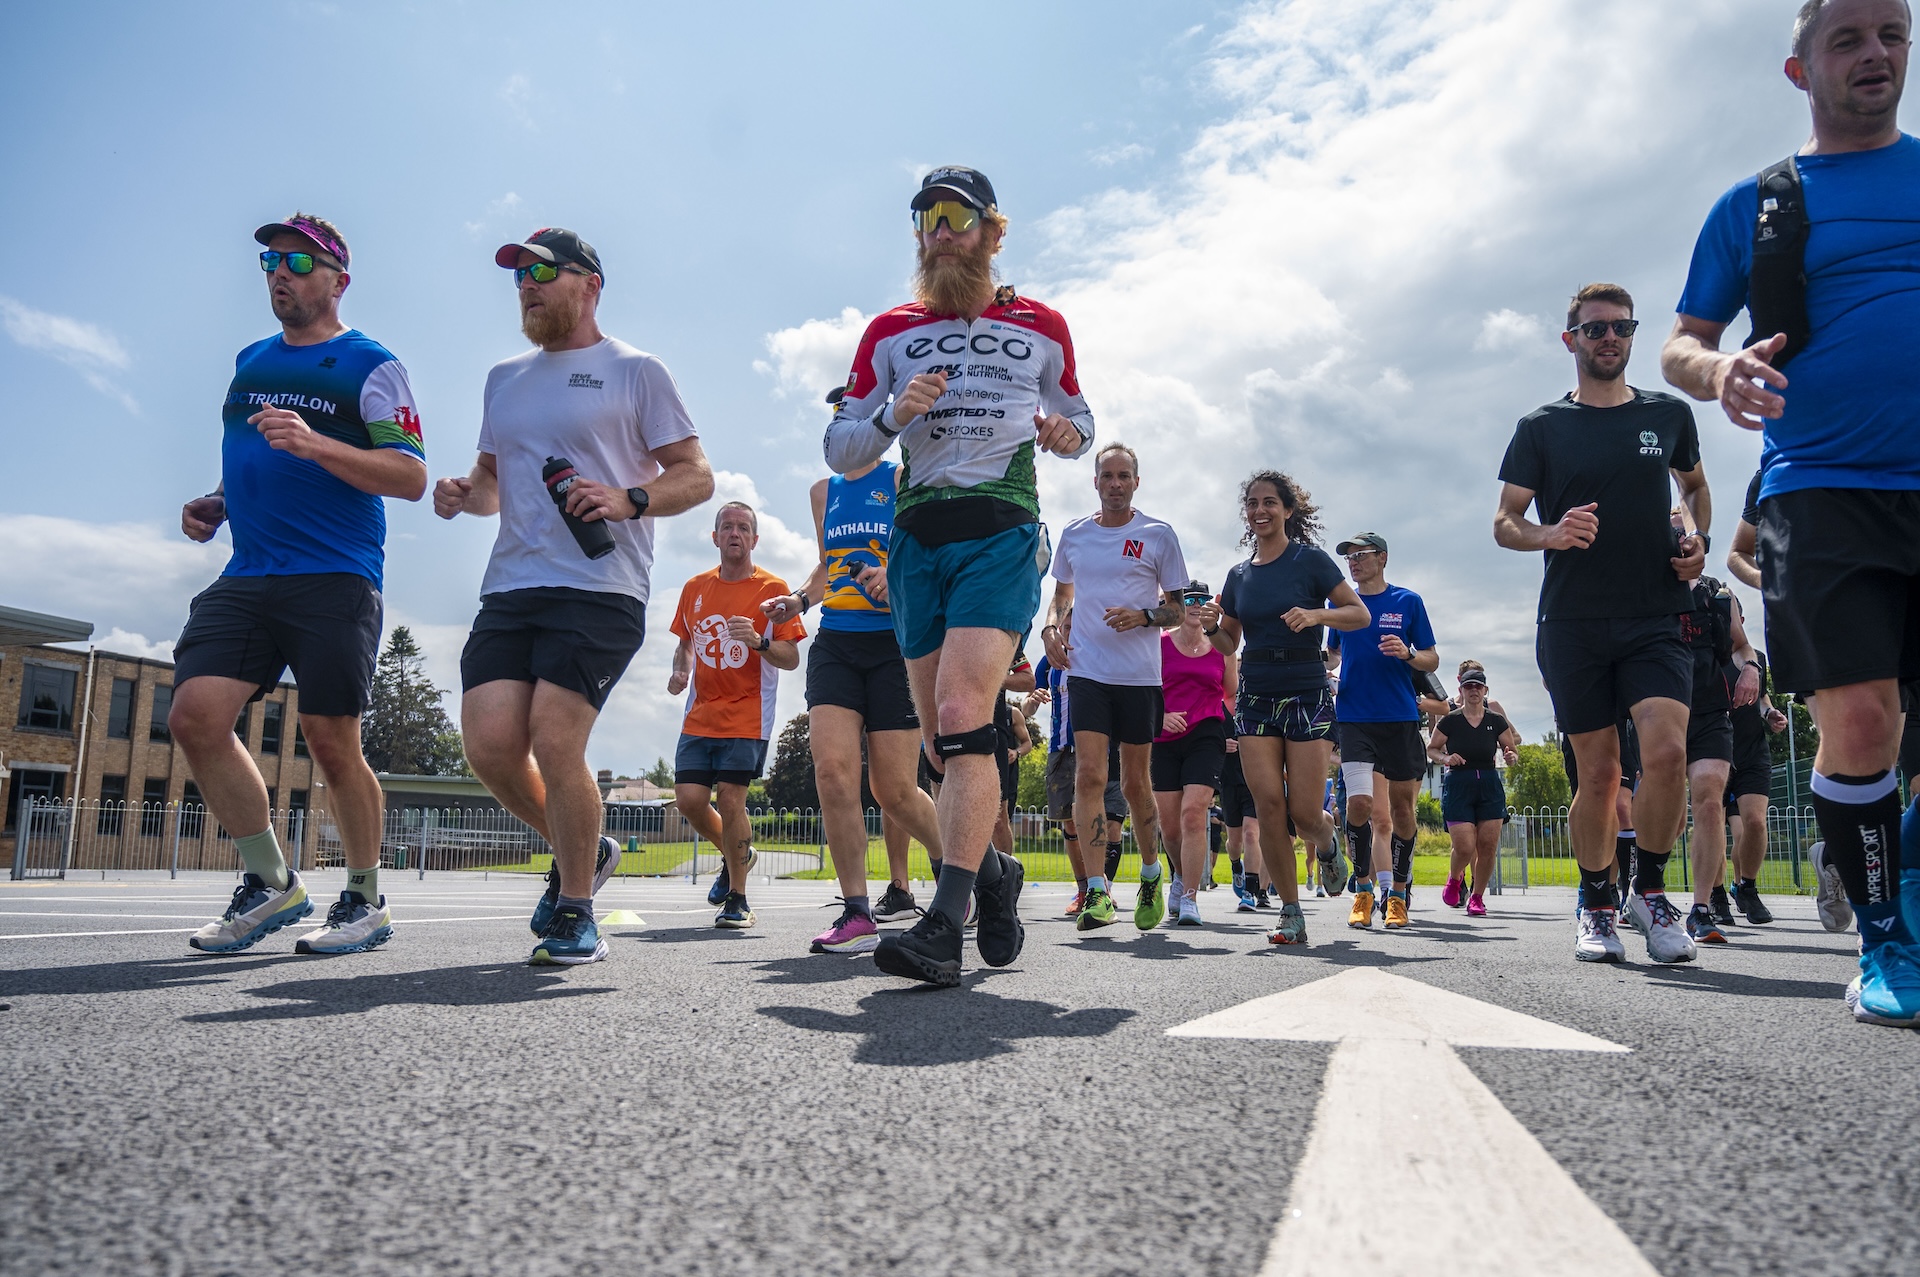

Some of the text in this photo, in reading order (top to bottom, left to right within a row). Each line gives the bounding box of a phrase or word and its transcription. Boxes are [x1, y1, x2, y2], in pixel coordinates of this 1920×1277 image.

[905, 334, 1031, 360] ecco
[967, 364, 1009, 374] OPTIMUM
[967, 370, 1013, 382] NUTRITION
[924, 407, 988, 421] TWISTED
[947, 425, 994, 437] SPOKES
[827, 521, 888, 540] NATHALIE
